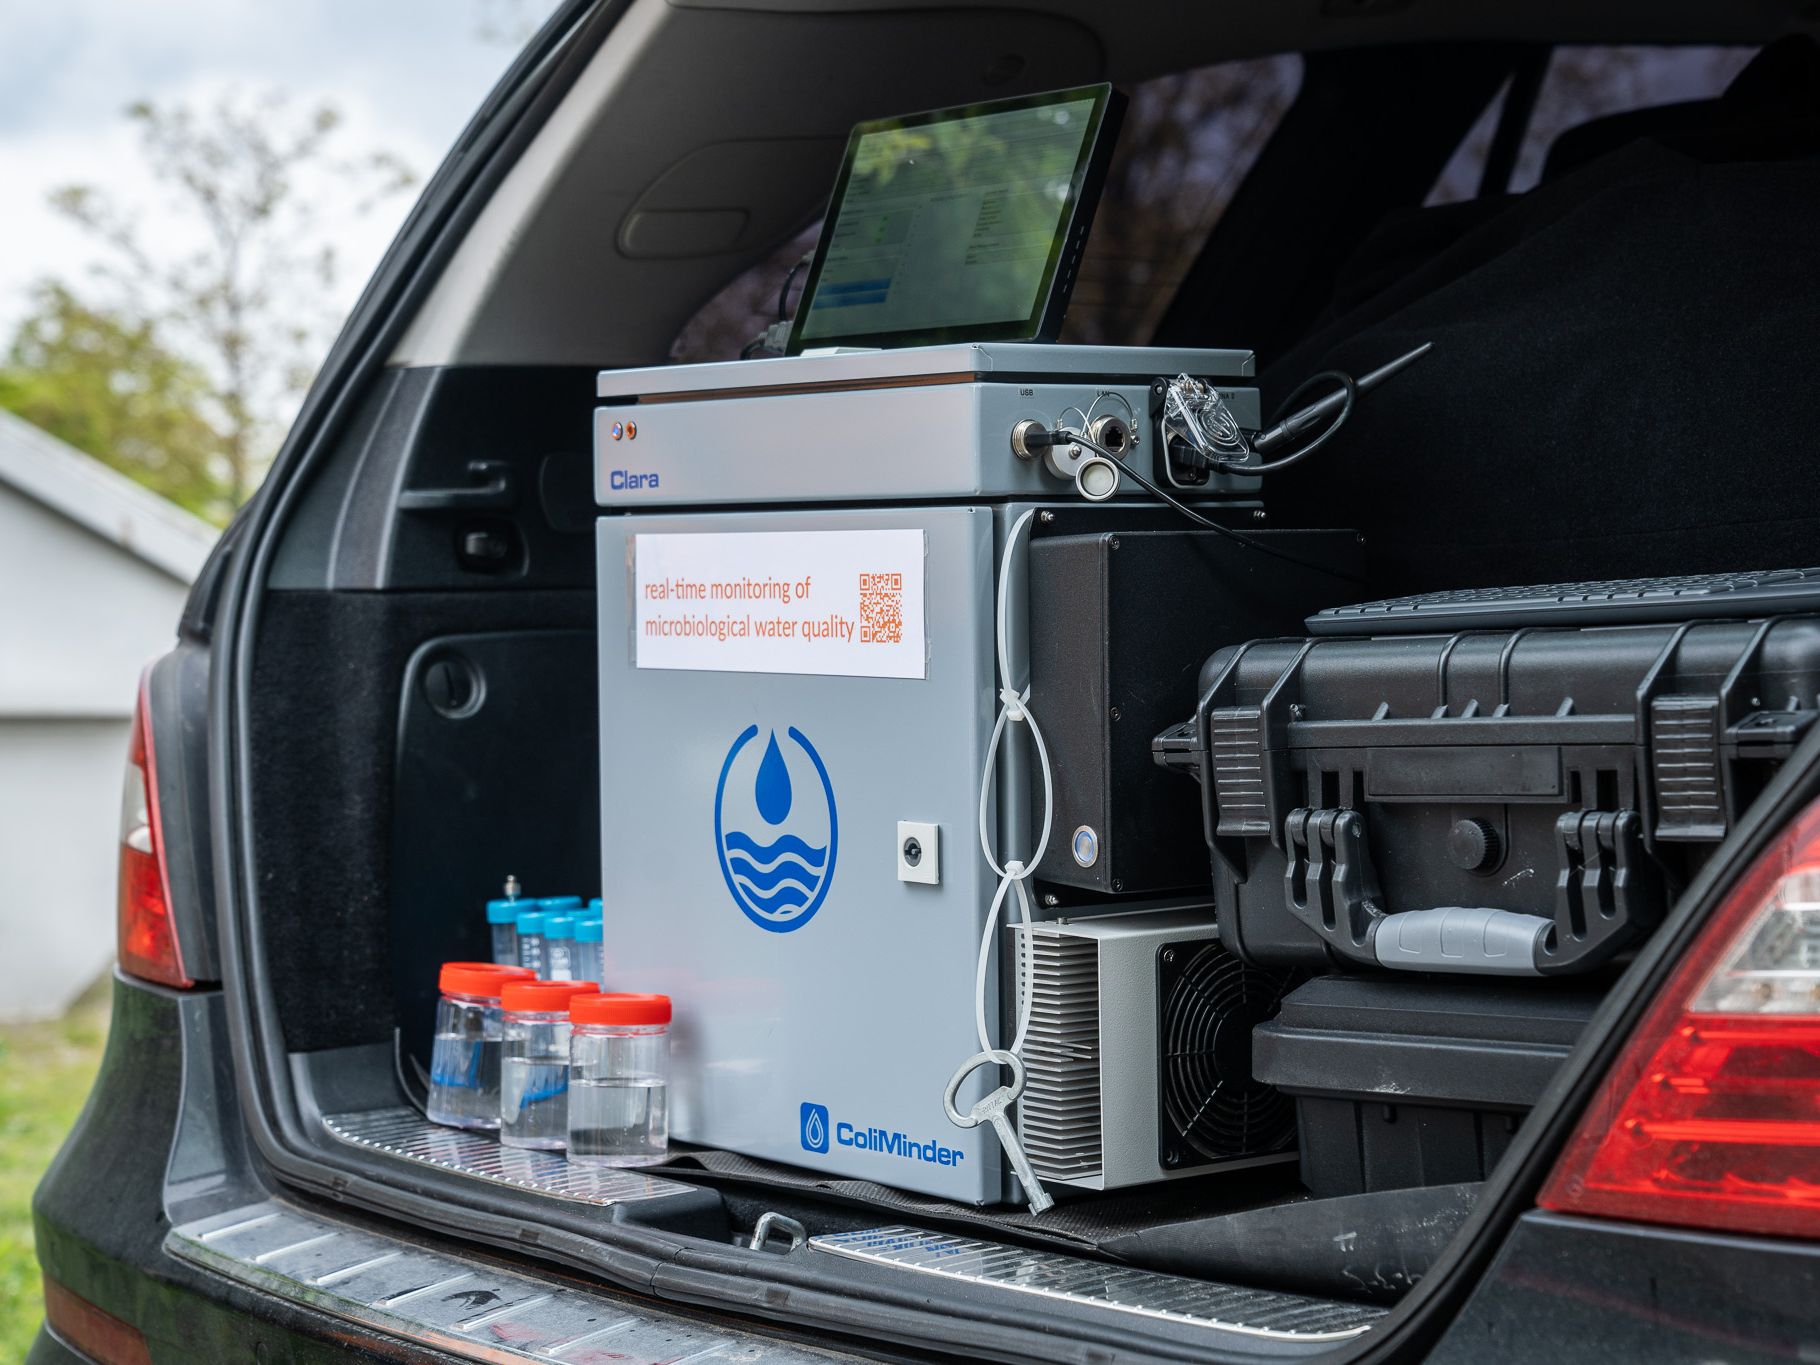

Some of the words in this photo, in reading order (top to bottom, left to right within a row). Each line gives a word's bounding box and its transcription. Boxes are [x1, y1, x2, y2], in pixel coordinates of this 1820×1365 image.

[1020, 388, 1034, 397] USB
[1097, 390, 1110, 398] LAN
[610, 470, 660, 490] Clara
[645, 577, 707, 600] real-time
[710, 576, 791, 605] monitoring
[794, 576, 811, 600] of
[645, 614, 750, 642] microbiological
[754, 616, 798, 638] water
[801, 614, 855, 643] quality
[836, 1122, 965, 1167] ColiMinder
